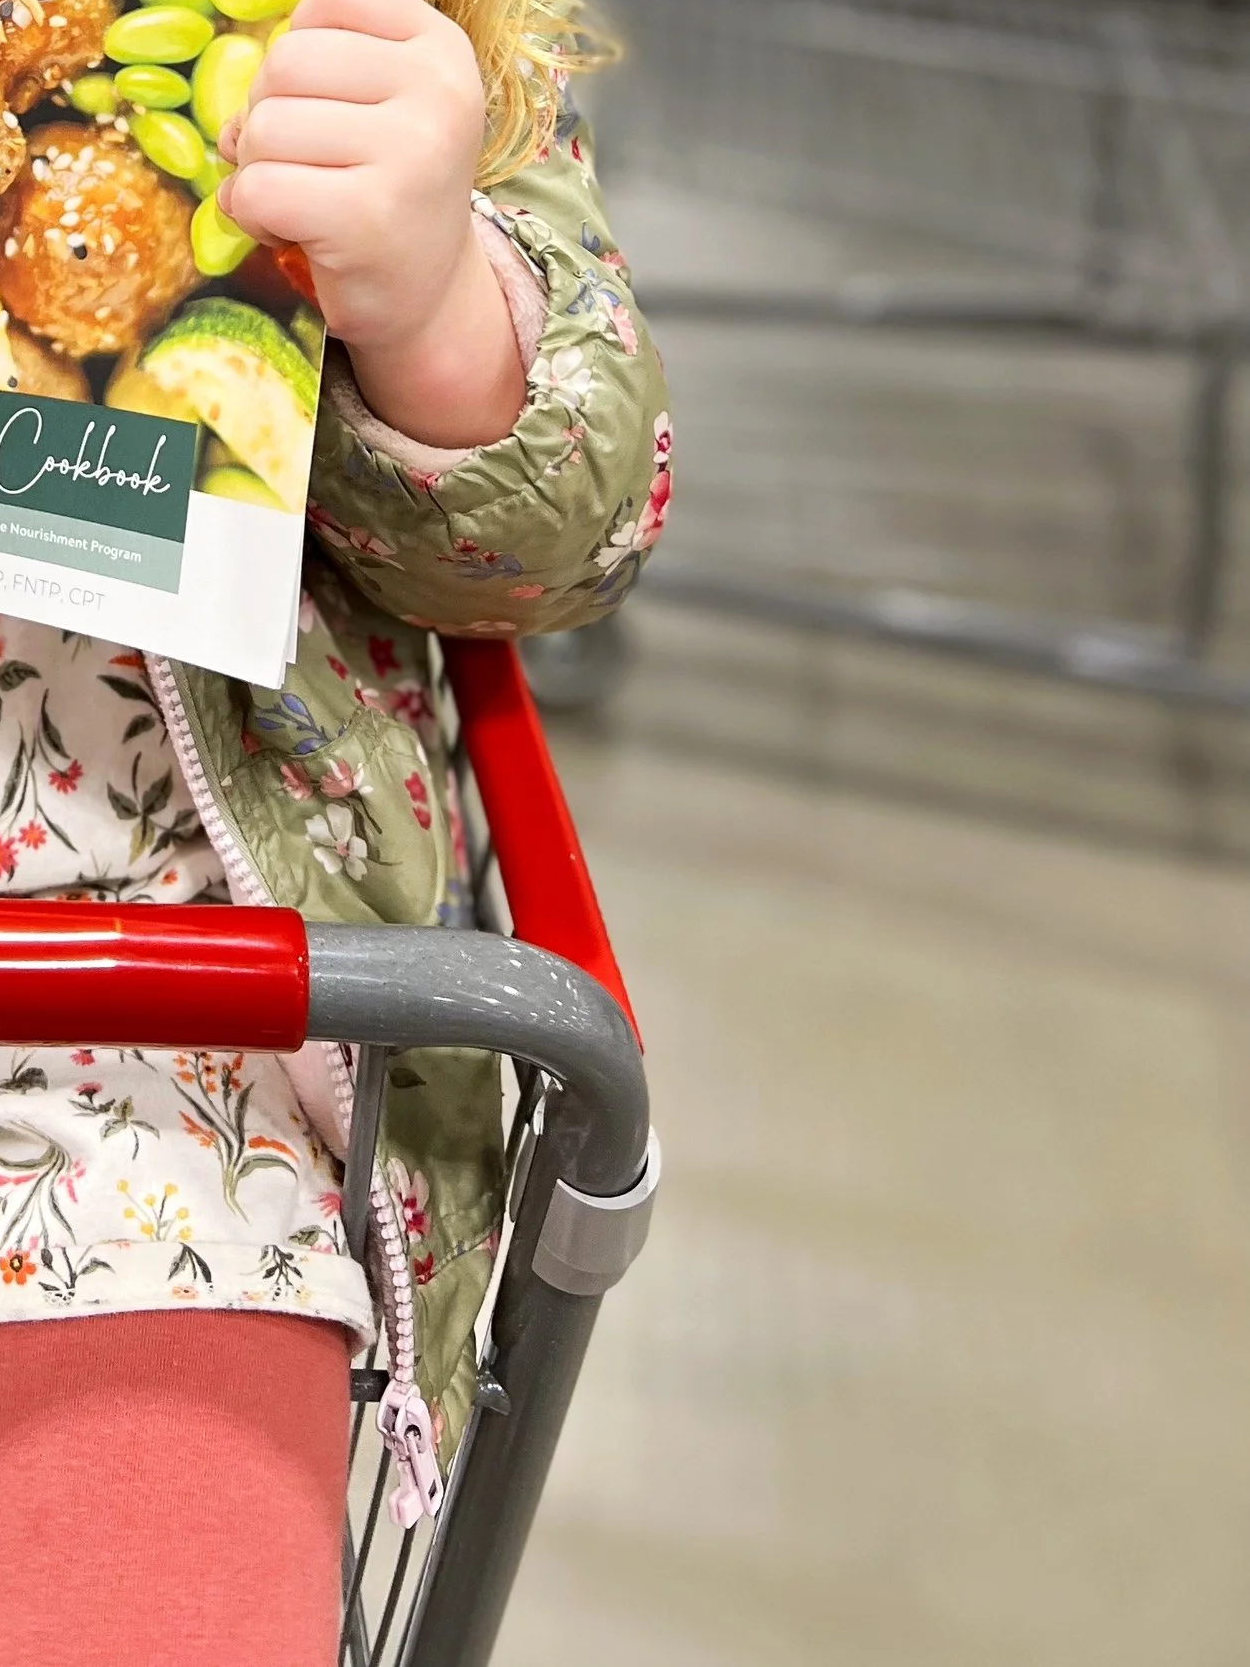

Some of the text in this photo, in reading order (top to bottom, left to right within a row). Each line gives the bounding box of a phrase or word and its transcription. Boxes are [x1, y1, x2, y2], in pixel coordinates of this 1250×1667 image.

[10, 523, 88, 550] Nourishment
[91, 540, 142, 563] Program
[68, 587, 106, 611] CPT
